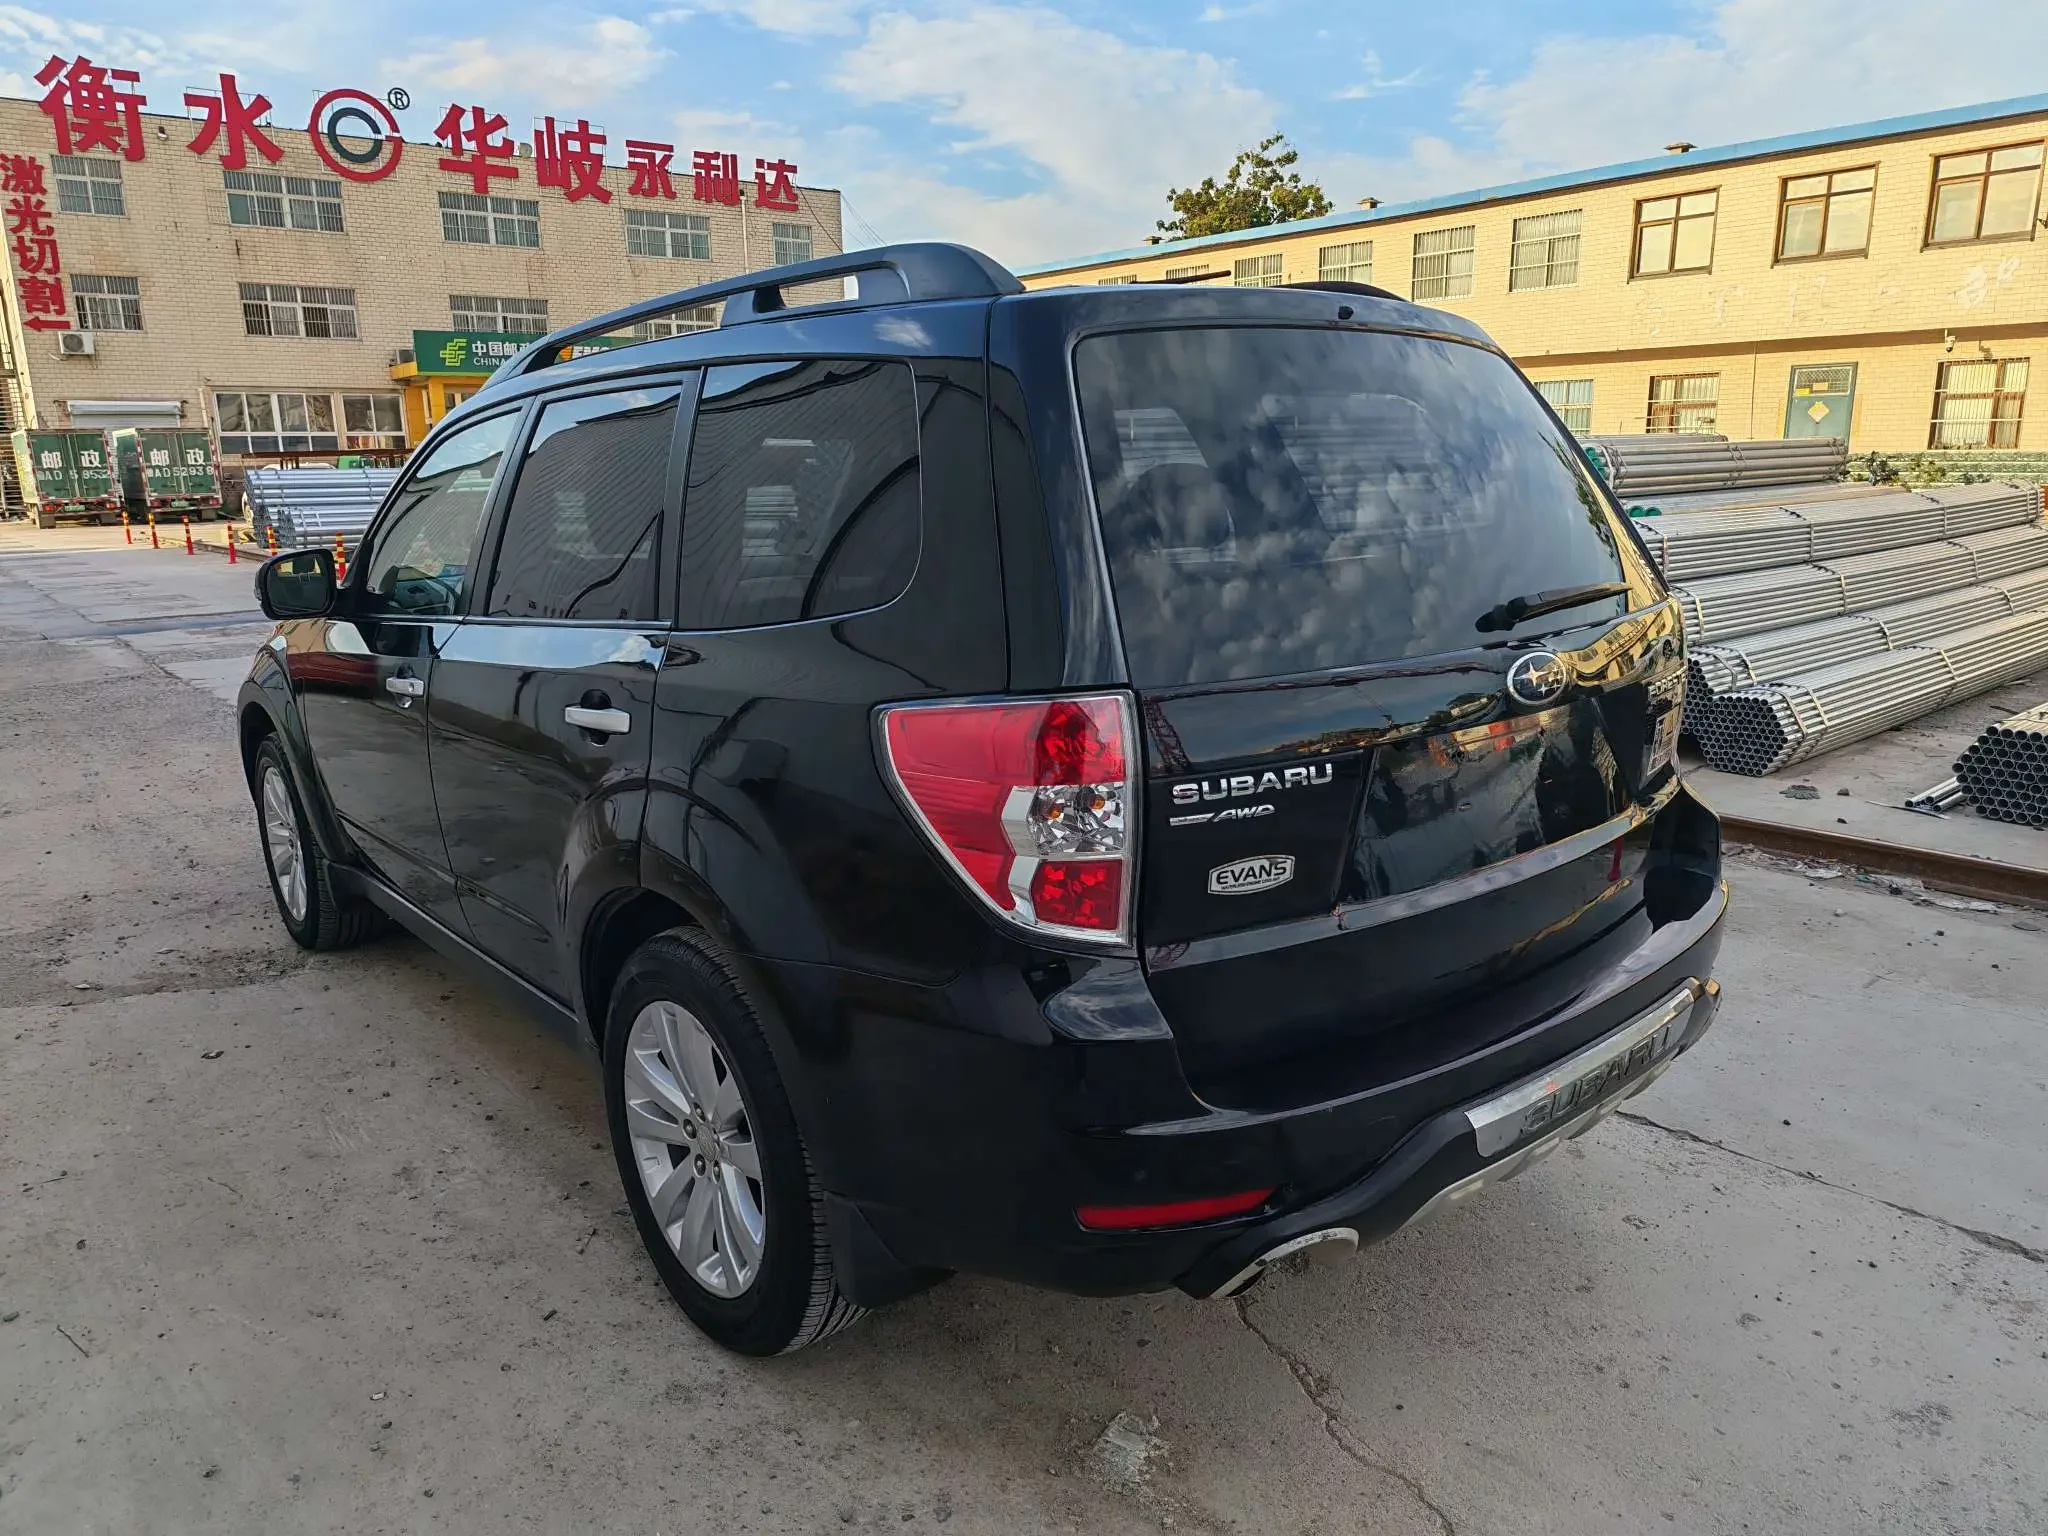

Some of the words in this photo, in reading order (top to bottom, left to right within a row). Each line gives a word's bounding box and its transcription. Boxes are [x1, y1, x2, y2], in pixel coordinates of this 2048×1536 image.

[0, 153, 66, 316] 激光切割
[1172, 763, 1333, 805] SUBARU
[1212, 804, 1276, 823] AWD
[1216, 860, 1287, 885] EVANS
[1520, 1023, 1672, 1137] SUBARU
